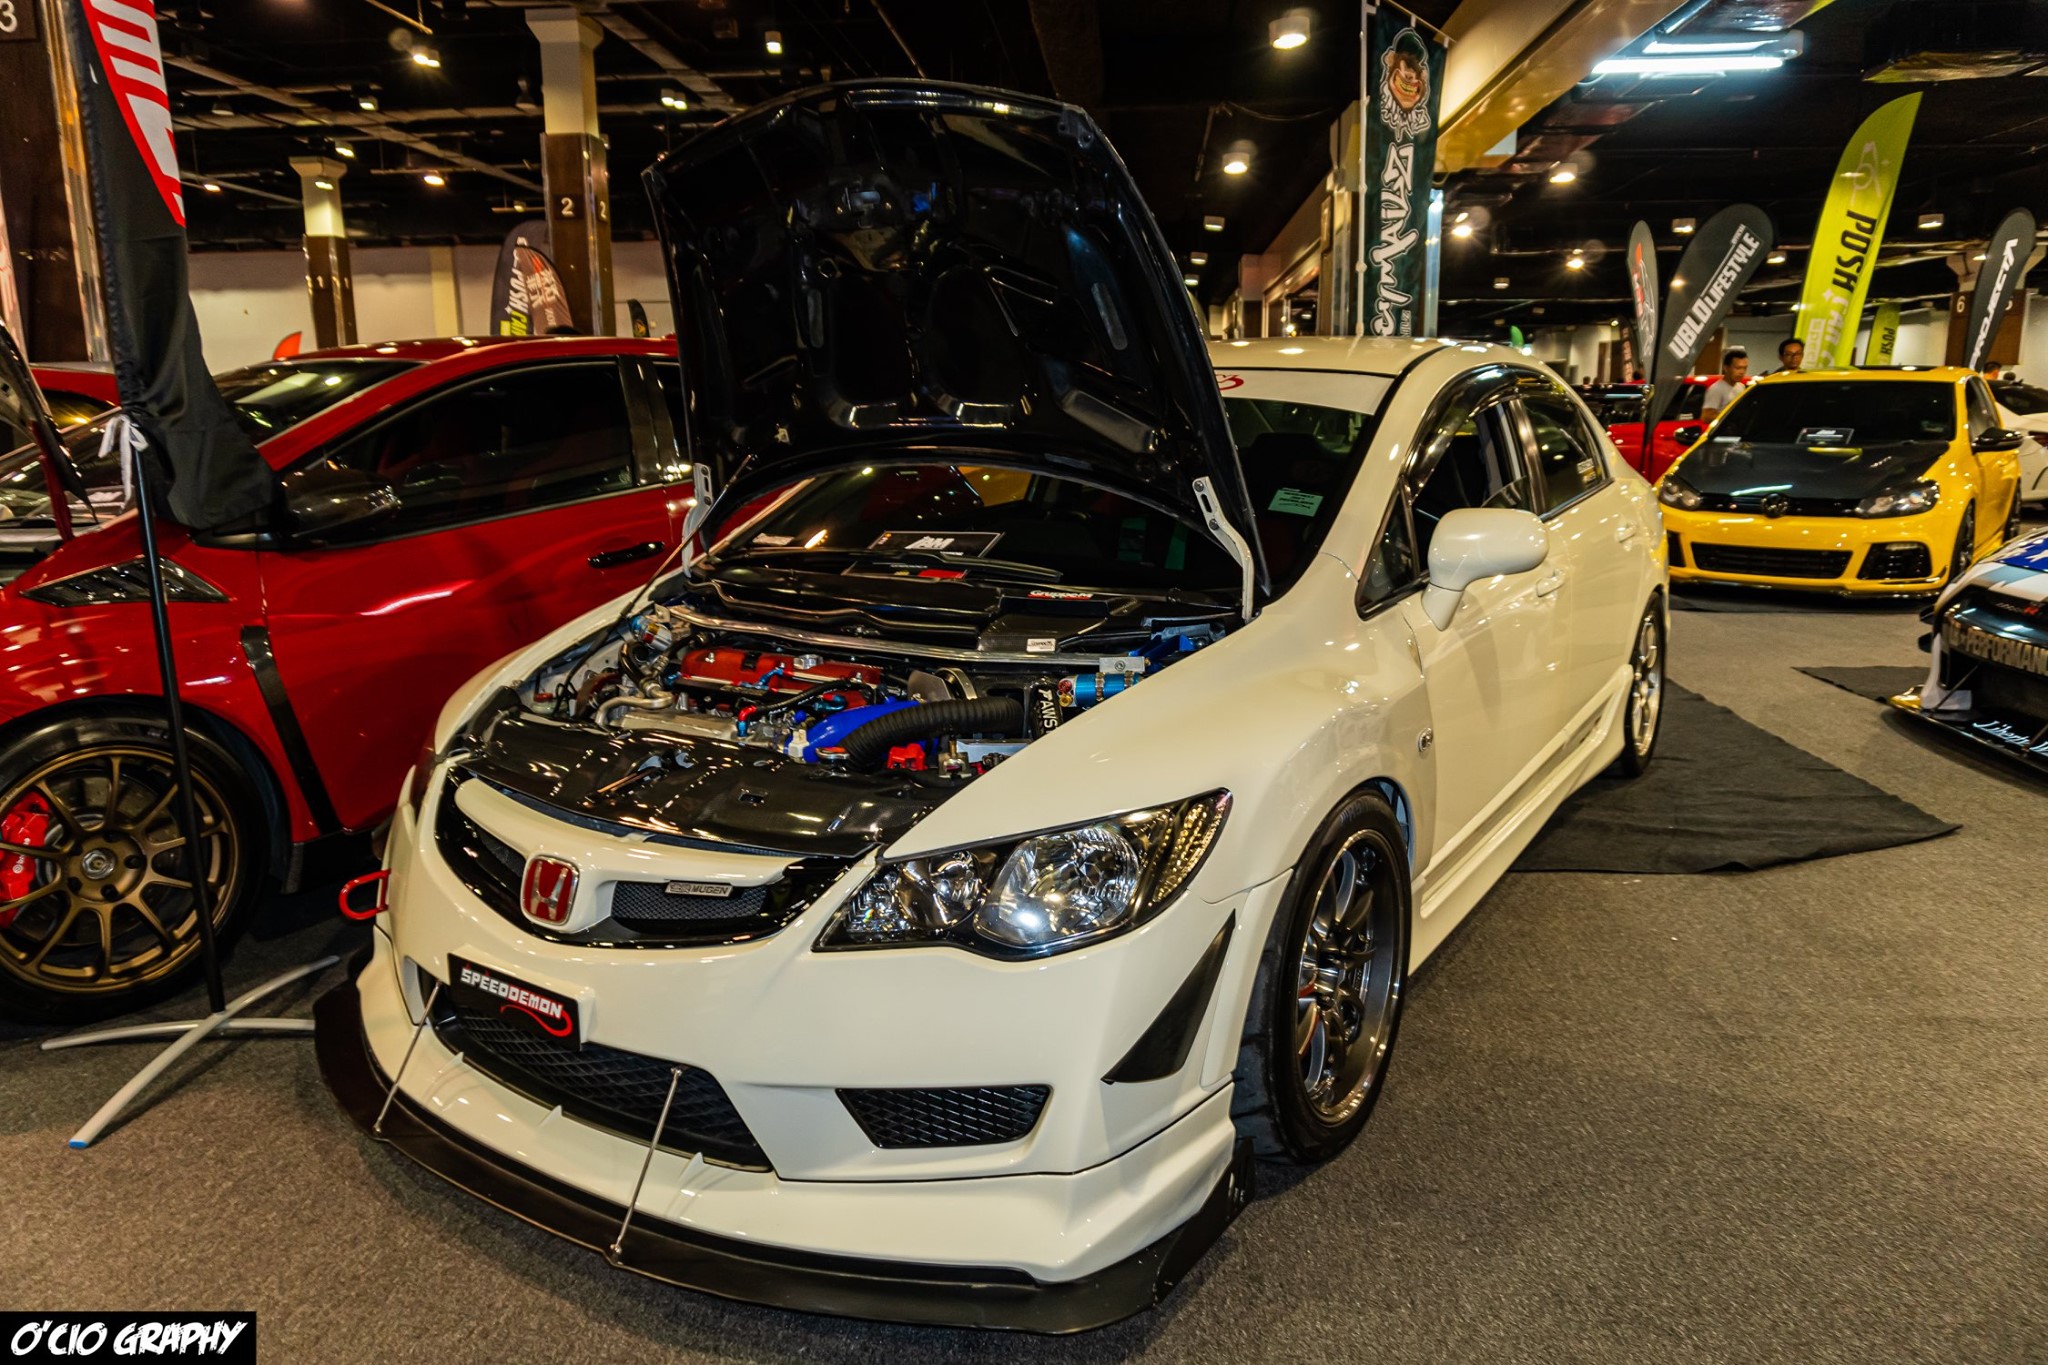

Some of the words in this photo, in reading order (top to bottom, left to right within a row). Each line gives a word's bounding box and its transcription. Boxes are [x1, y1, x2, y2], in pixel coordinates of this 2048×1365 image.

[561, 197, 575, 217] 2
[1832, 209, 1877, 294] POSH
[1956, 295, 1966, 314] 6
[691, 885, 730, 896] MUGEN
